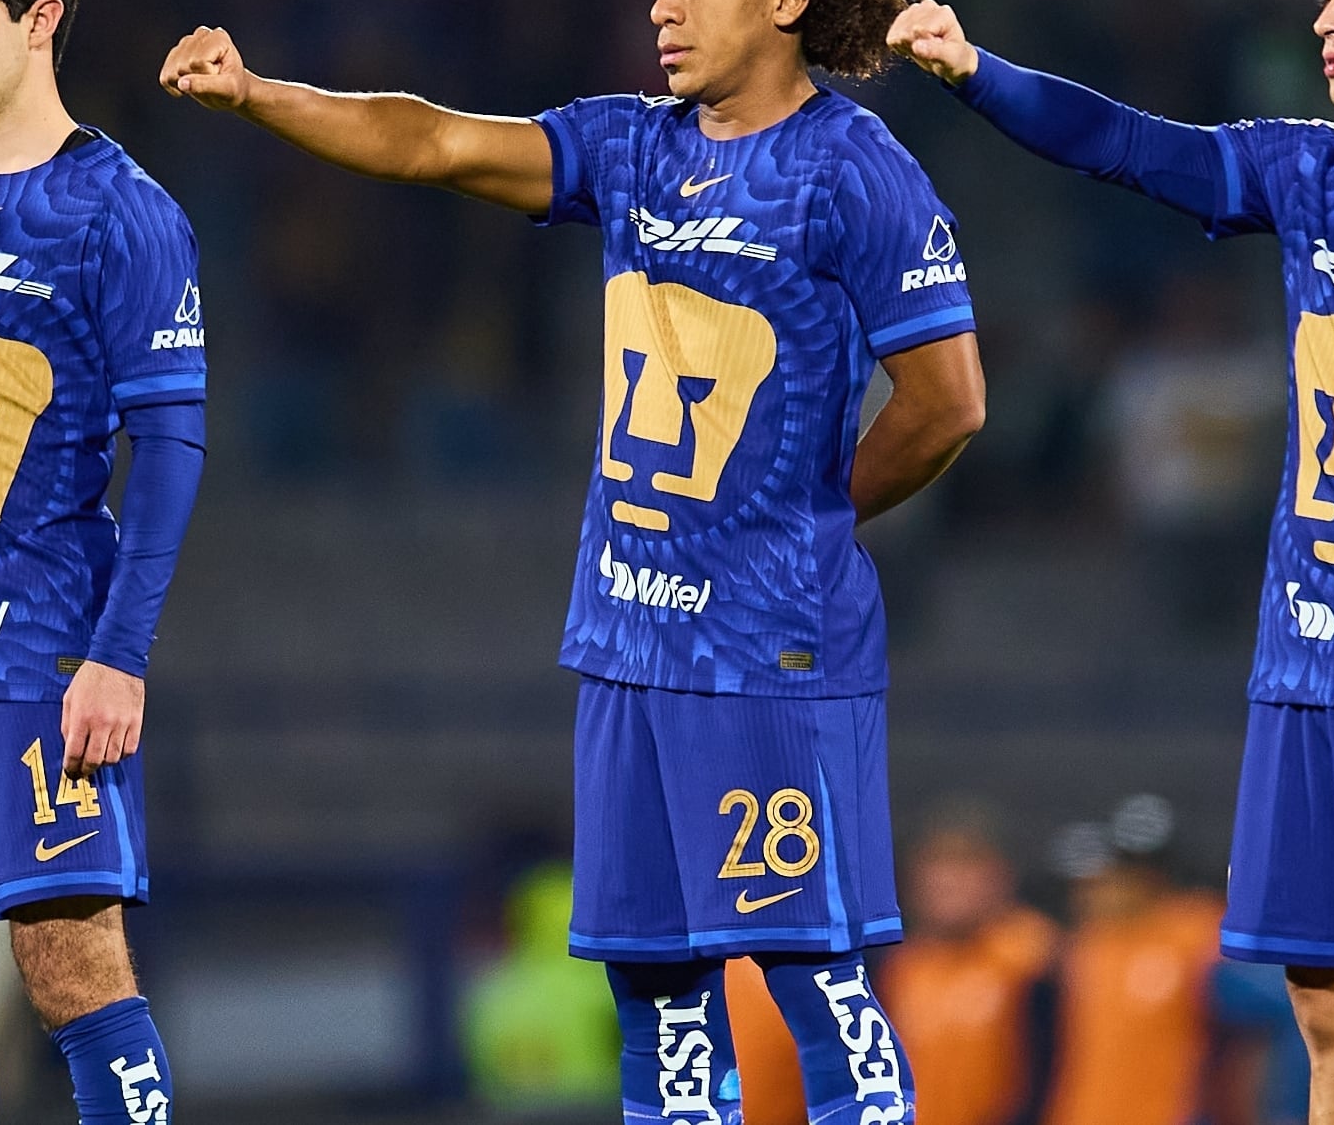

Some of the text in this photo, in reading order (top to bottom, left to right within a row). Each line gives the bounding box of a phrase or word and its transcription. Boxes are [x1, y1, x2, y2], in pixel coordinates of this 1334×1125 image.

[638, 207, 746, 256] DHL
[636, 567, 711, 614] Mifel
[20, 736, 101, 825] 14
[717, 788, 821, 879] 28
[653, 993, 722, 1125] EST
